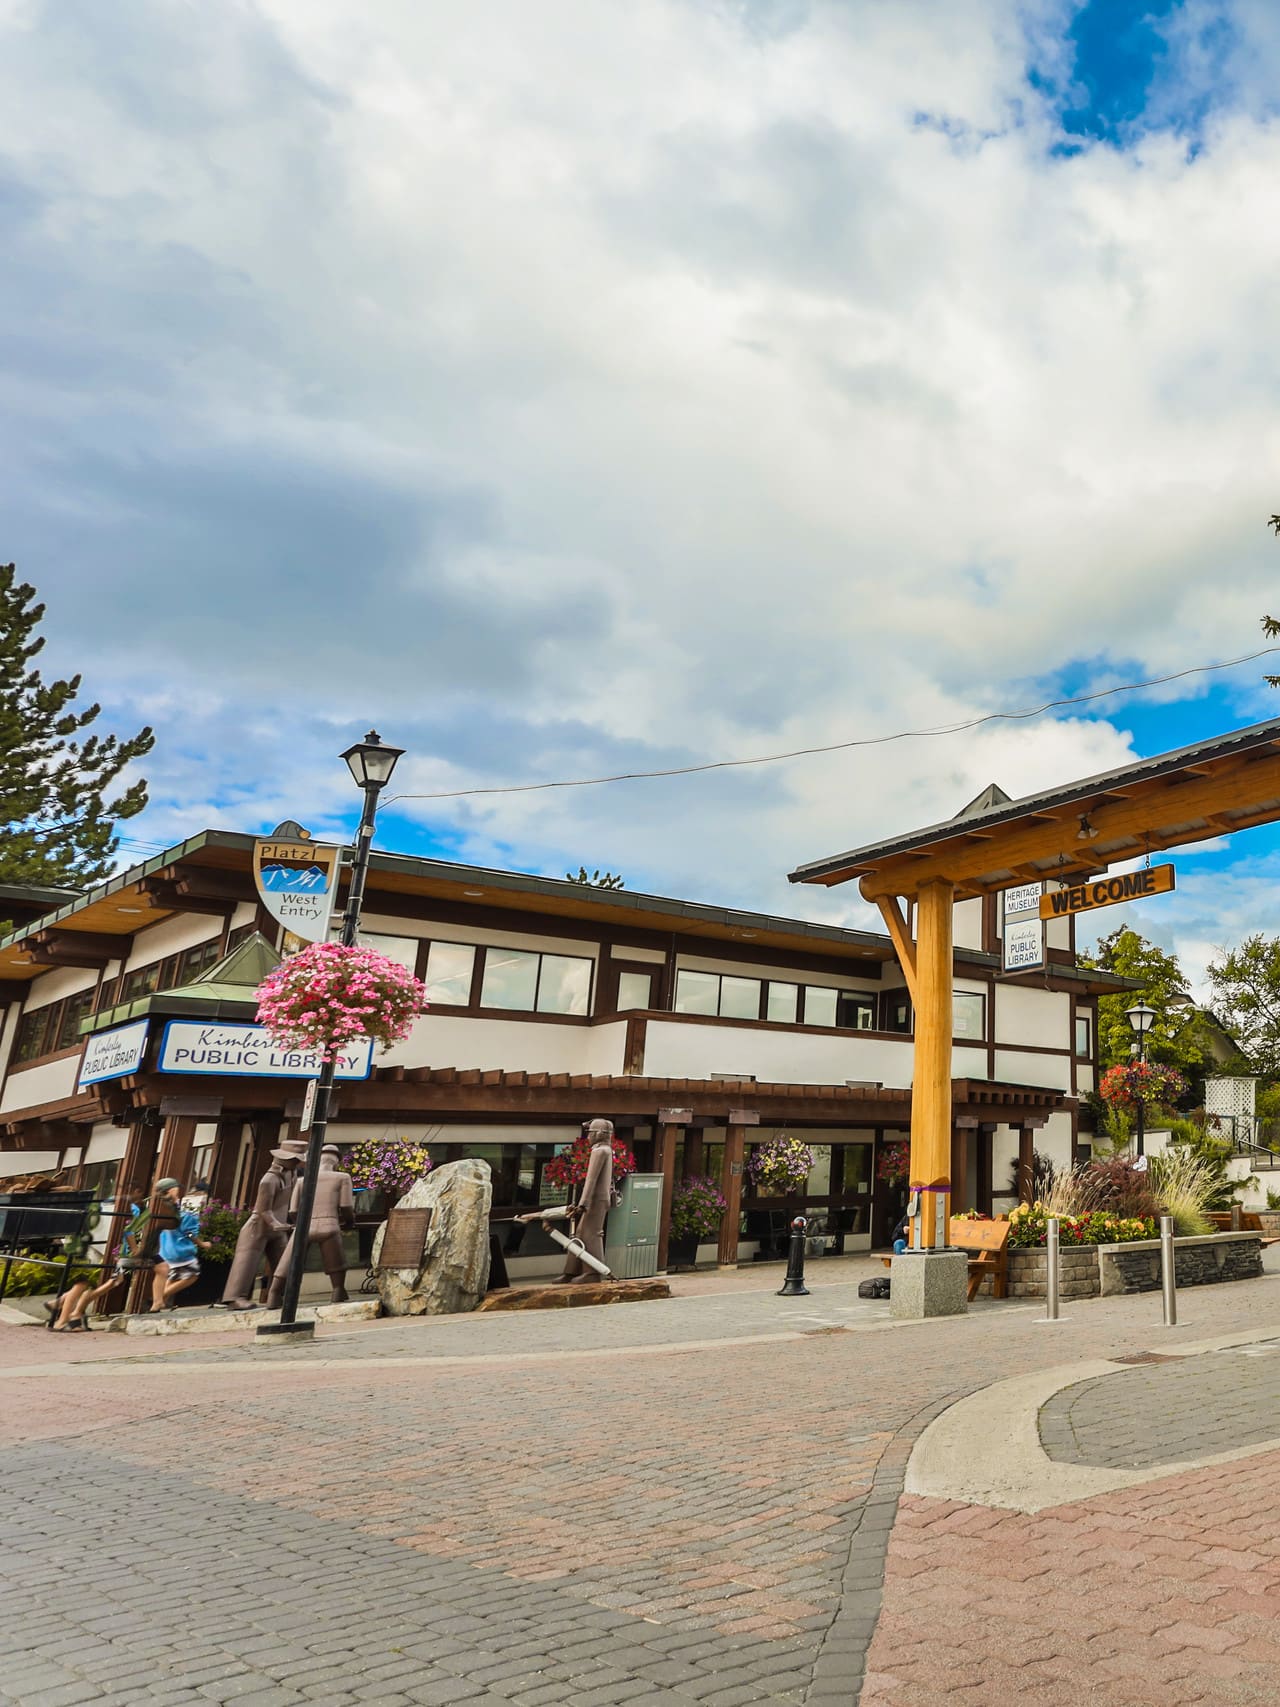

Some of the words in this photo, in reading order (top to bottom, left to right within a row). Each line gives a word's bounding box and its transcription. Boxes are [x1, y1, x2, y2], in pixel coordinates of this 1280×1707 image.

[261, 846, 316, 860] Platzl
[282, 893, 319, 905] West
[1007, 886, 1040, 901] HERITAGE
[1051, 869, 1155, 914] WELCOME
[1008, 897, 1039, 912] MUSEUM
[280, 905, 322, 921] Entry
[1010, 940, 1037, 954] PUBLIC
[1008, 951, 1039, 966] LIBRARY
[84, 1055, 109, 1076] PUBLIC
[108, 1047, 139, 1069] LIBRARY
[175, 1047, 259, 1066] PUBLIC
[269, 1053, 359, 1070] LIBRY
